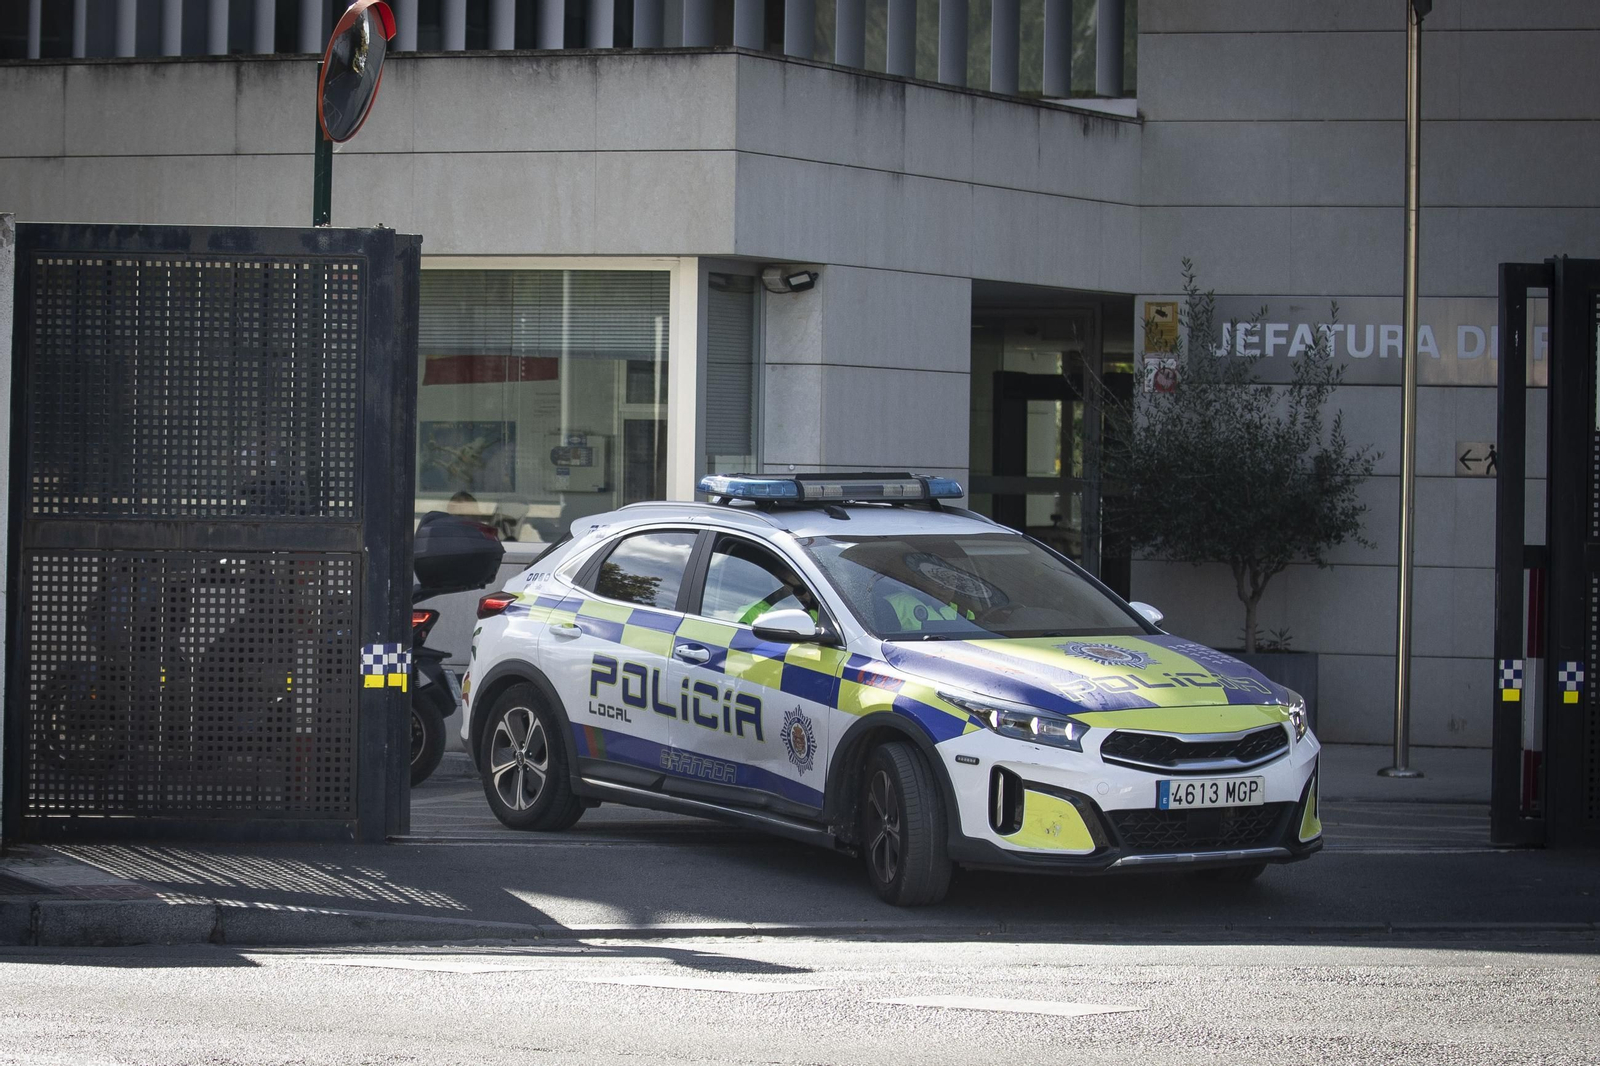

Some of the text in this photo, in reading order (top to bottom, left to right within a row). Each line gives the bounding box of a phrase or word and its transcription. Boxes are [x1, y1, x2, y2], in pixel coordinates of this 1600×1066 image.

[1209, 323, 1440, 359] JEFATURA
[1457, 325, 1499, 360] D
[589, 701, 632, 723] LOCAL
[660, 749, 737, 783] GRANADA
[1173, 783, 1218, 805] 4613
[1226, 781, 1259, 803] MGP
